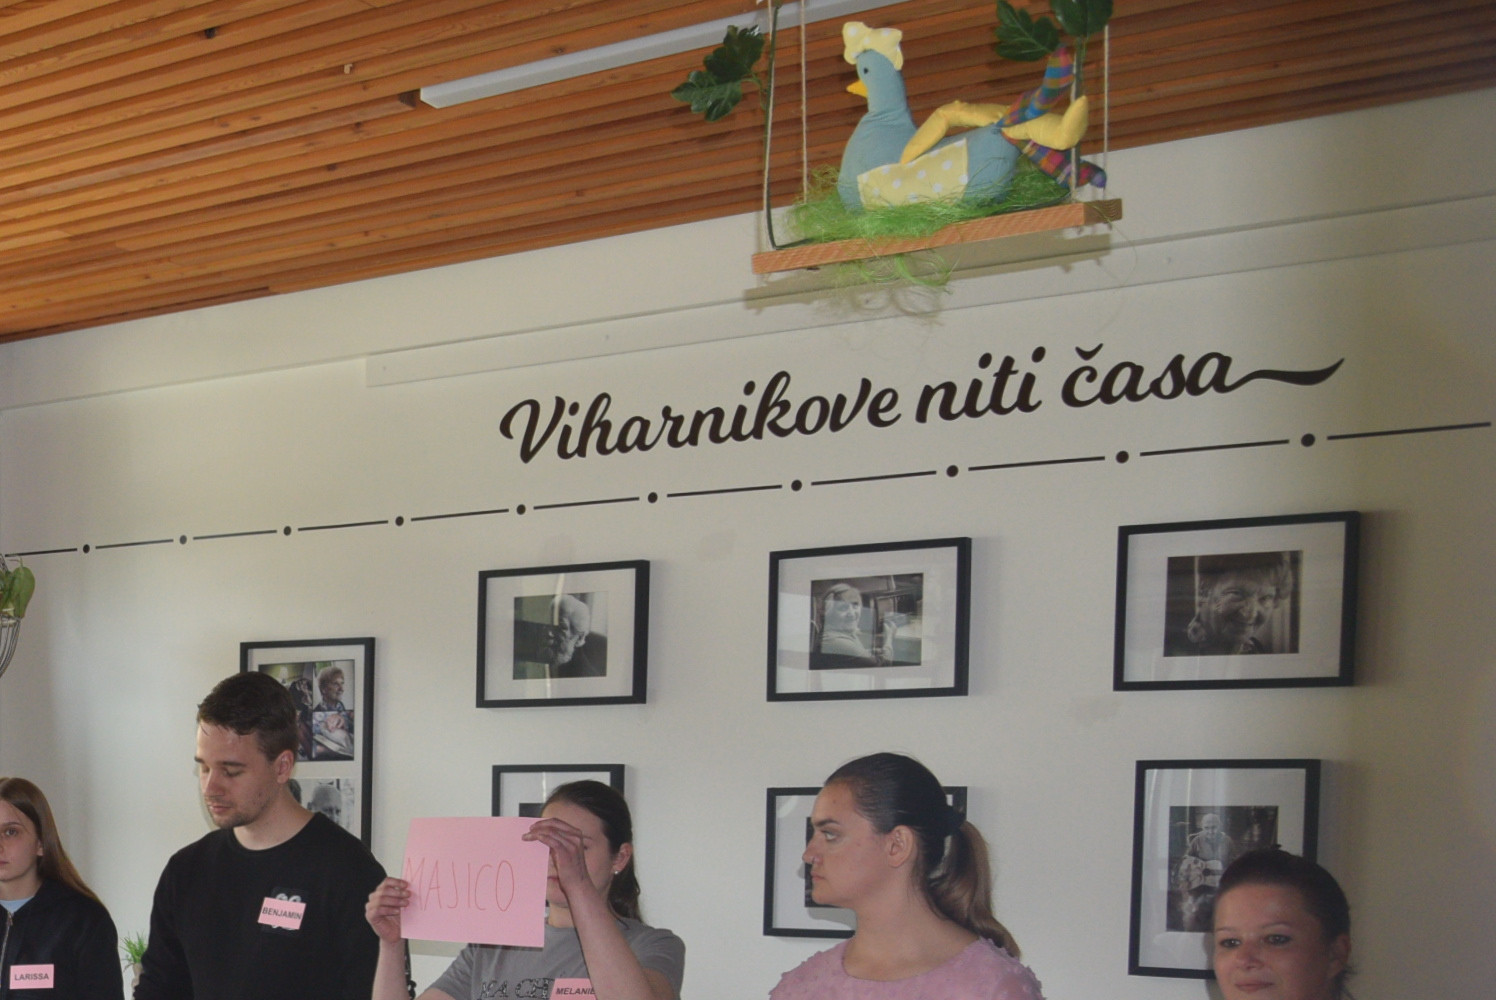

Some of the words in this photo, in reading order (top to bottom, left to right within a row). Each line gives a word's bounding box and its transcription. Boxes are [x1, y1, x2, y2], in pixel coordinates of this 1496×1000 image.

[500, 370, 902, 464] Viharnikove
[916, 346, 1045, 424] niti
[1061, 342, 1344, 408] časa
[405, 857, 515, 912] MAJICO
[262, 906, 302, 920] BENJAMIN
[14, 973, 49, 981] LARISSA
